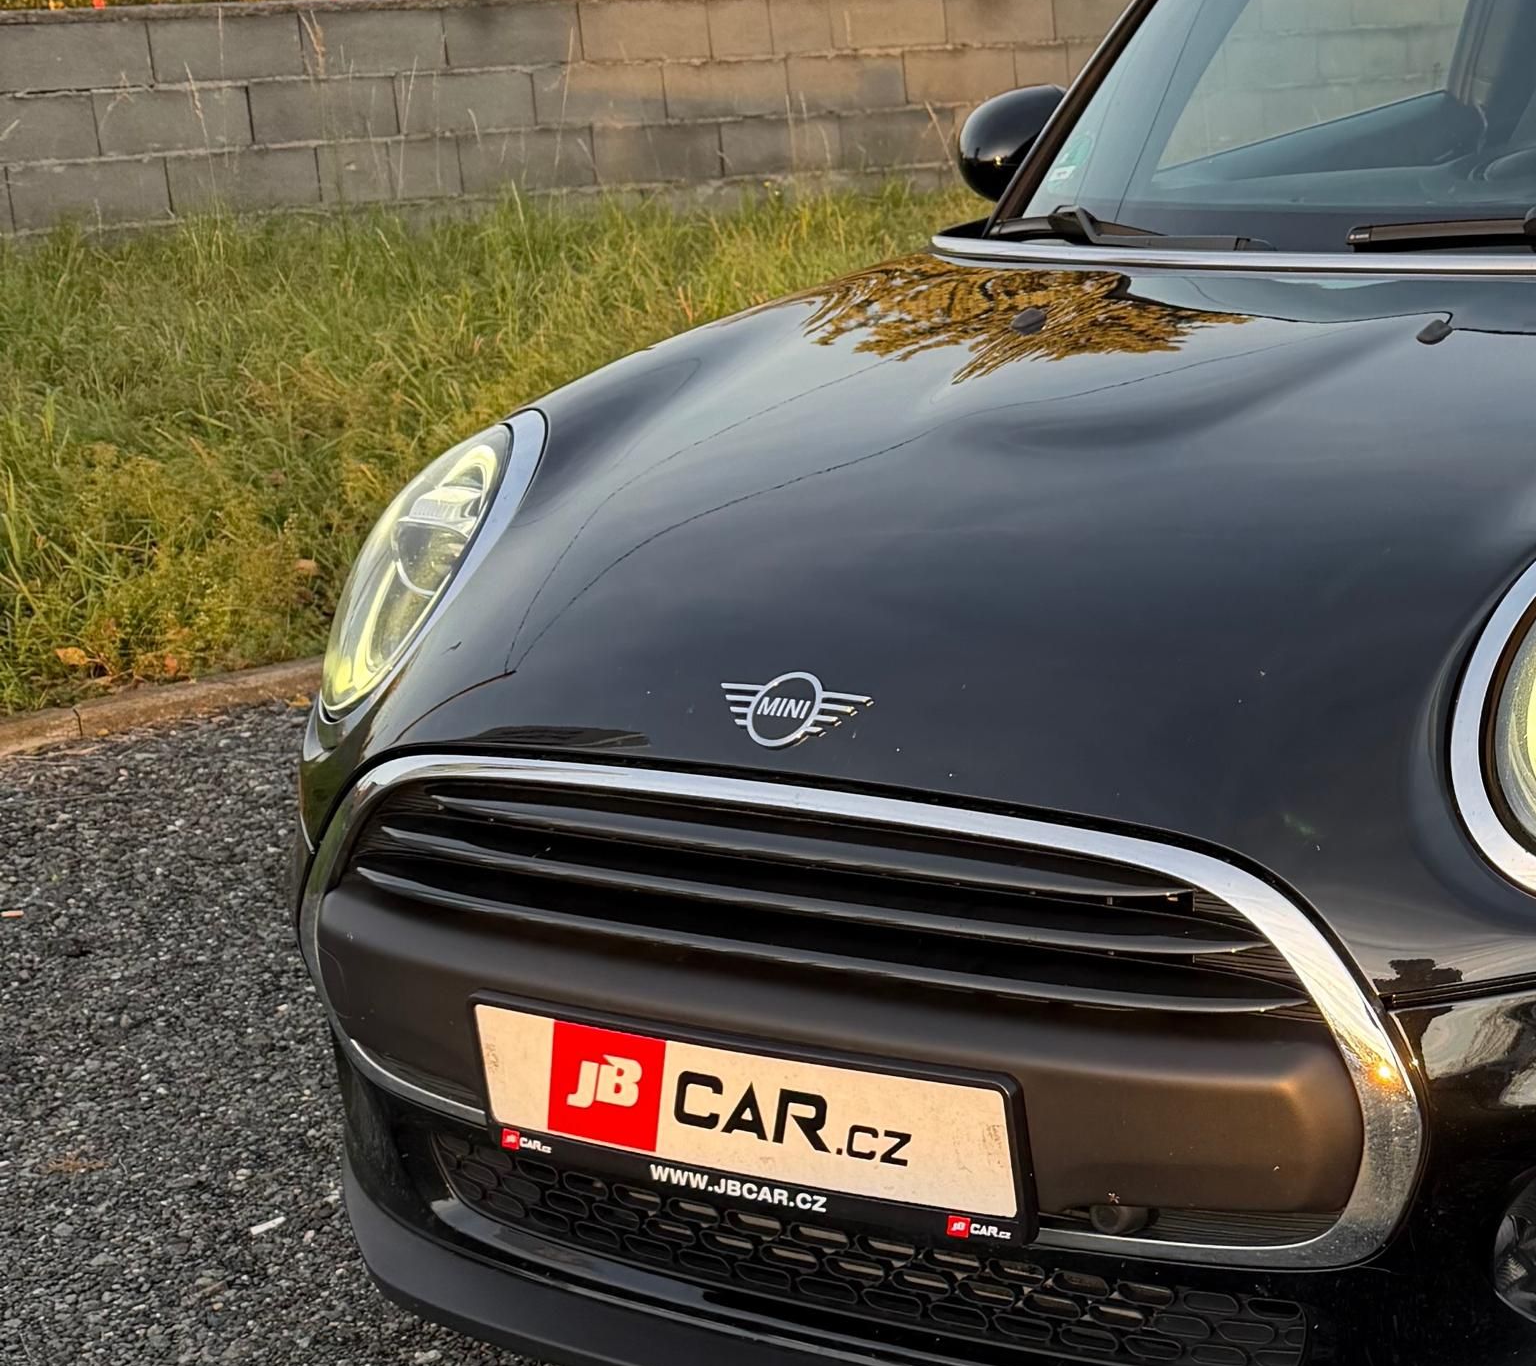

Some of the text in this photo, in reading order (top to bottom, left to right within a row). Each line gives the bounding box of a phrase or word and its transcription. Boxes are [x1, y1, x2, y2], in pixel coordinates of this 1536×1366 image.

[756, 696, 812, 720] MINI
[566, 1054, 643, 1109] JB
[650, 1164, 828, 1213] WWW.JBCAR.CZ
